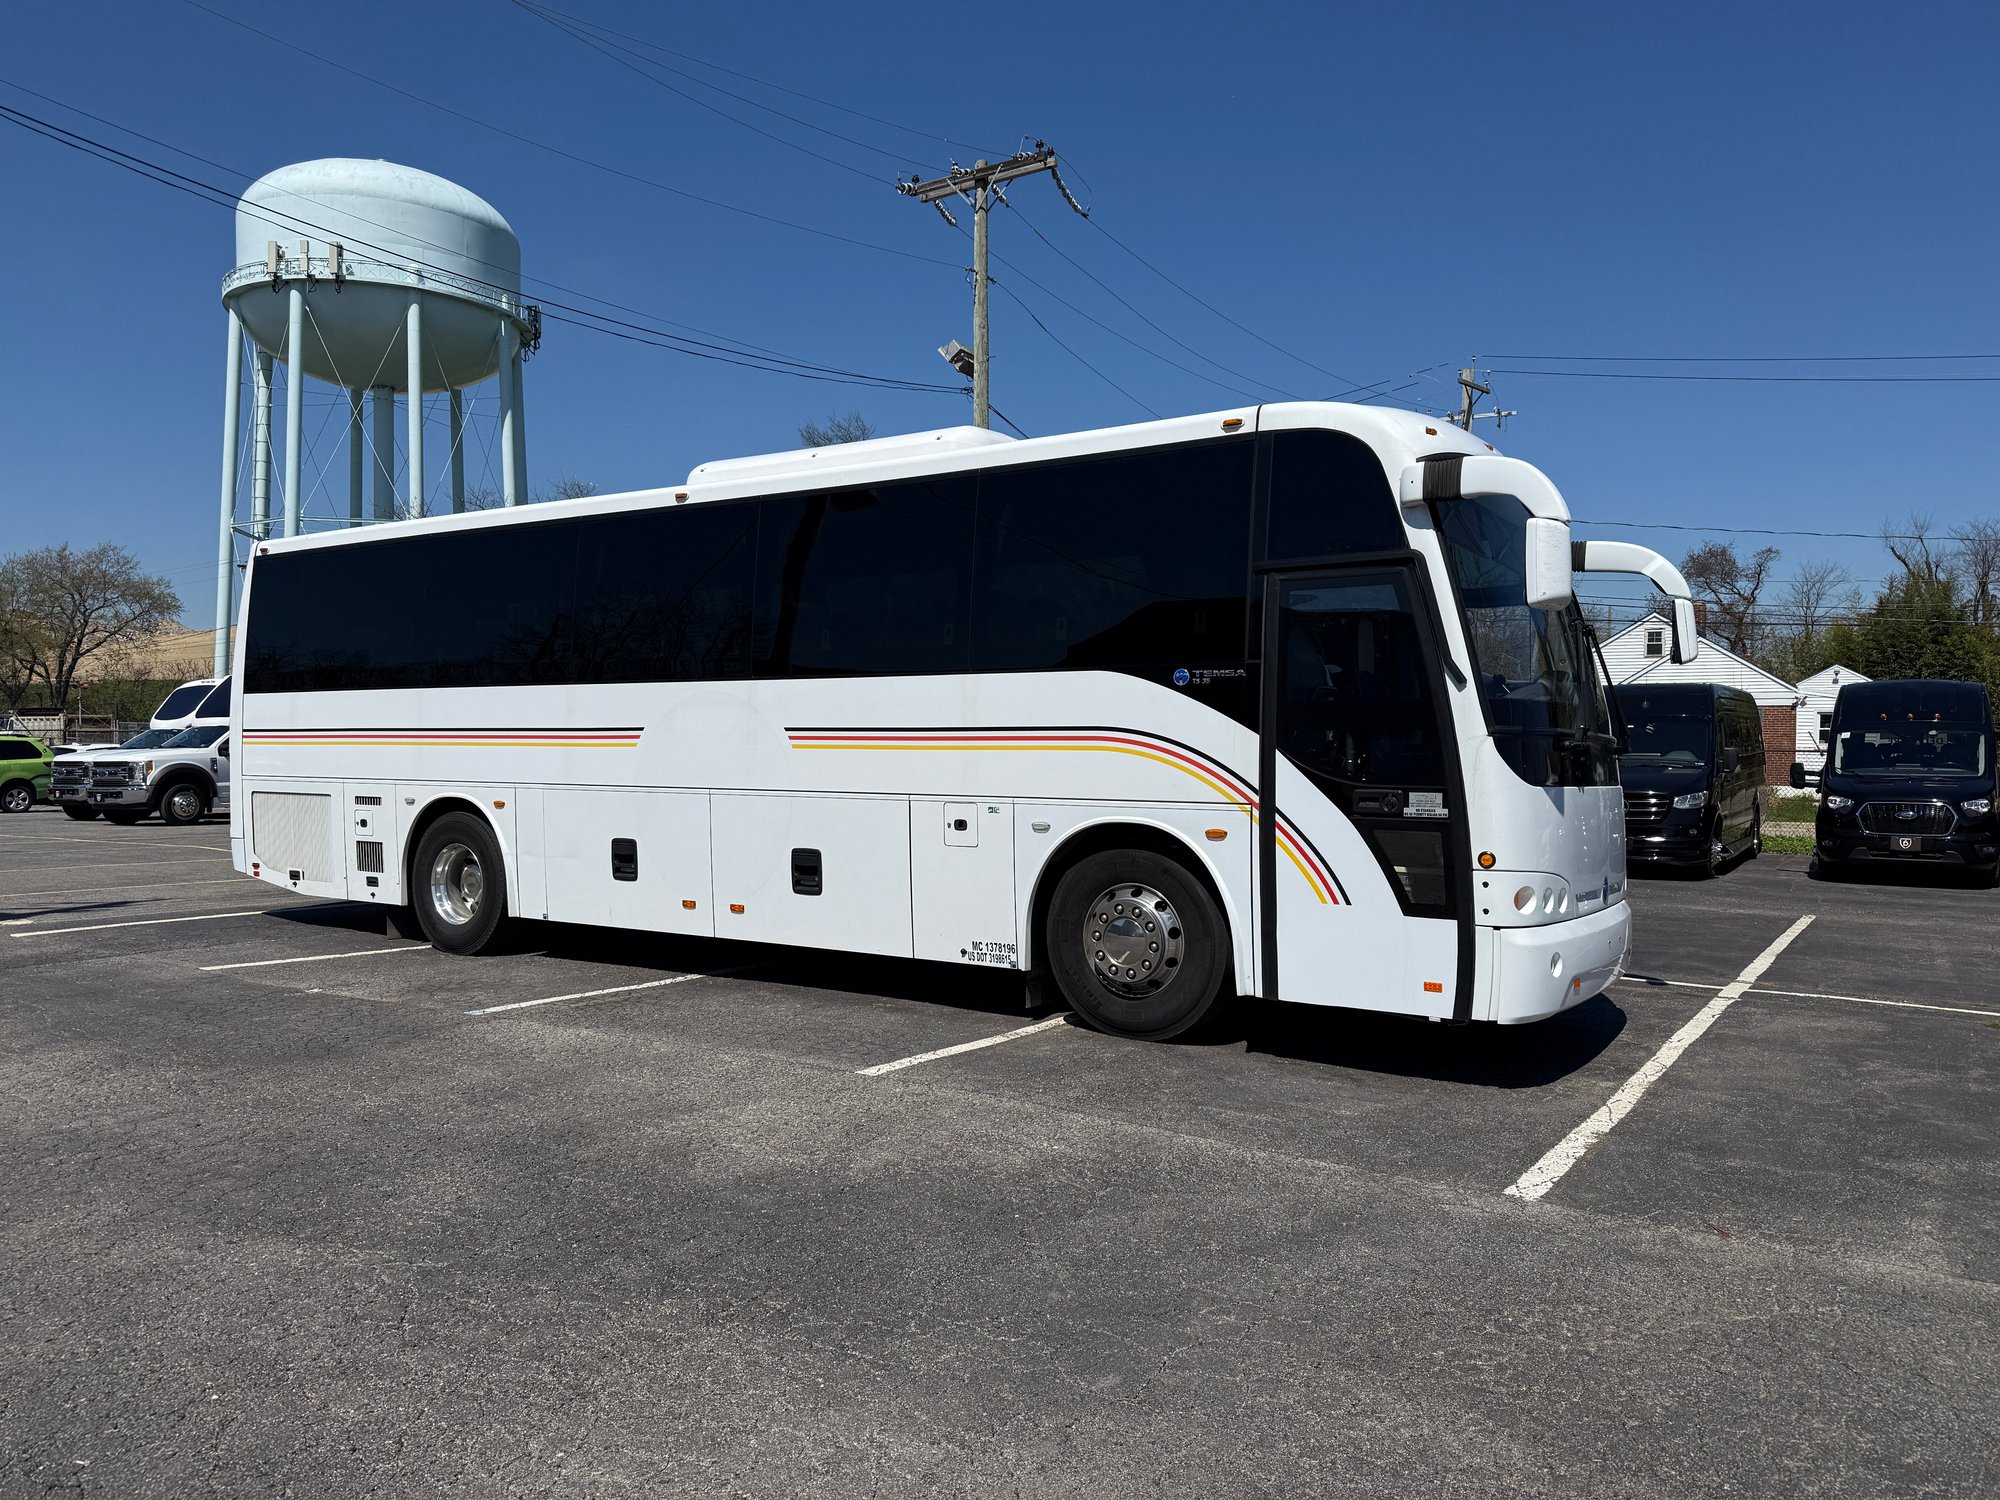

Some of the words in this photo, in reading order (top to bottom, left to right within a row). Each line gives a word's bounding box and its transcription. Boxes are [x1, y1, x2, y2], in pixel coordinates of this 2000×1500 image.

[1192, 669, 1246, 677] TEMSA
[972, 941, 983, 951] MC
[985, 942, 1015, 954] 1378196
[968, 951, 975, 961] US
[976, 952, 987, 962] DOT
